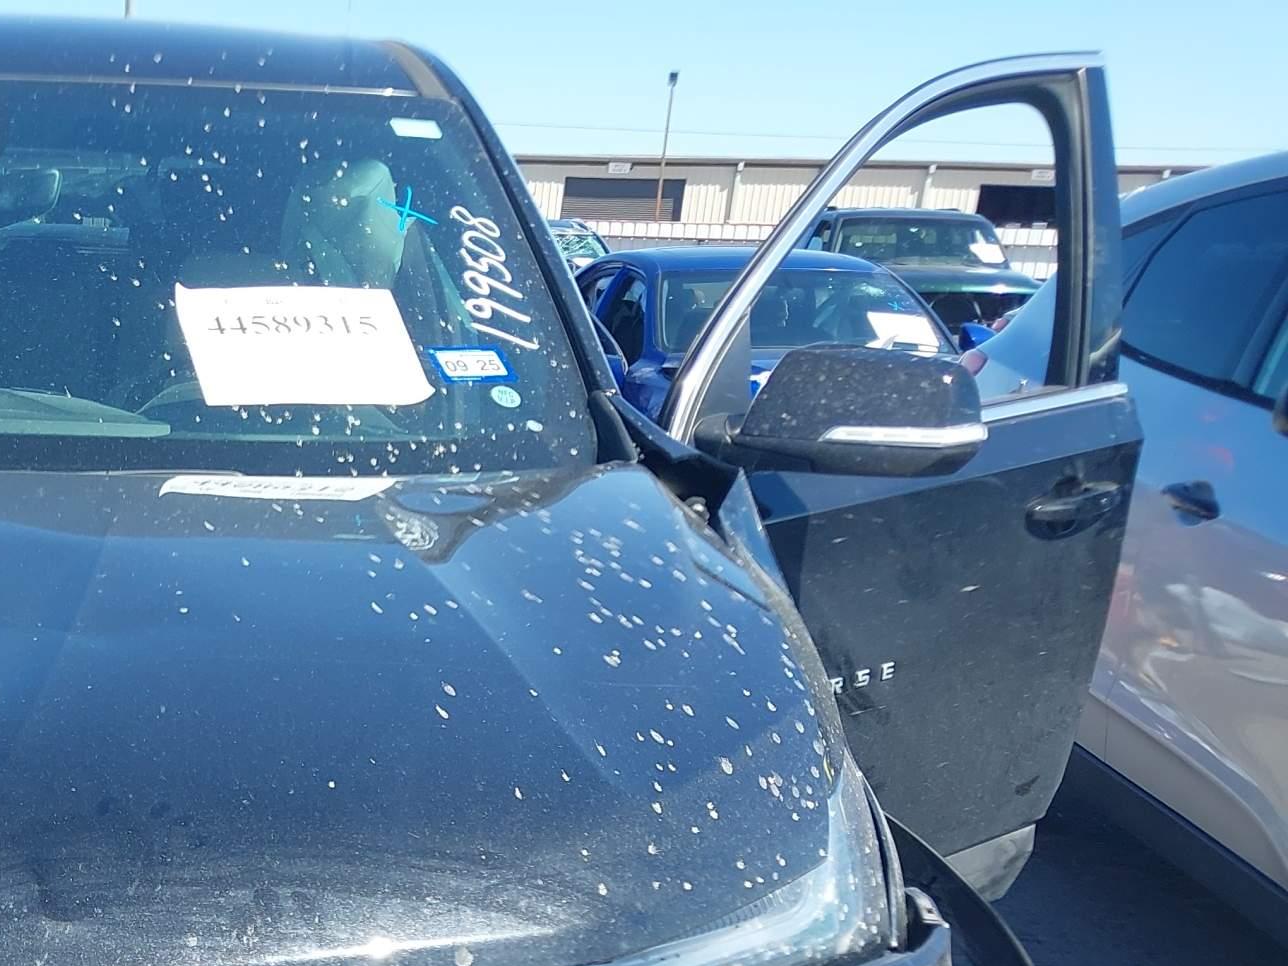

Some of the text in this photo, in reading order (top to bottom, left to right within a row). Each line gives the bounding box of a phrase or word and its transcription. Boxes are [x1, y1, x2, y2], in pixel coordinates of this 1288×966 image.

[449, 205, 540, 350] 199508
[208, 315, 378, 335] 44589315
[444, 359, 501, 372] 09 25
